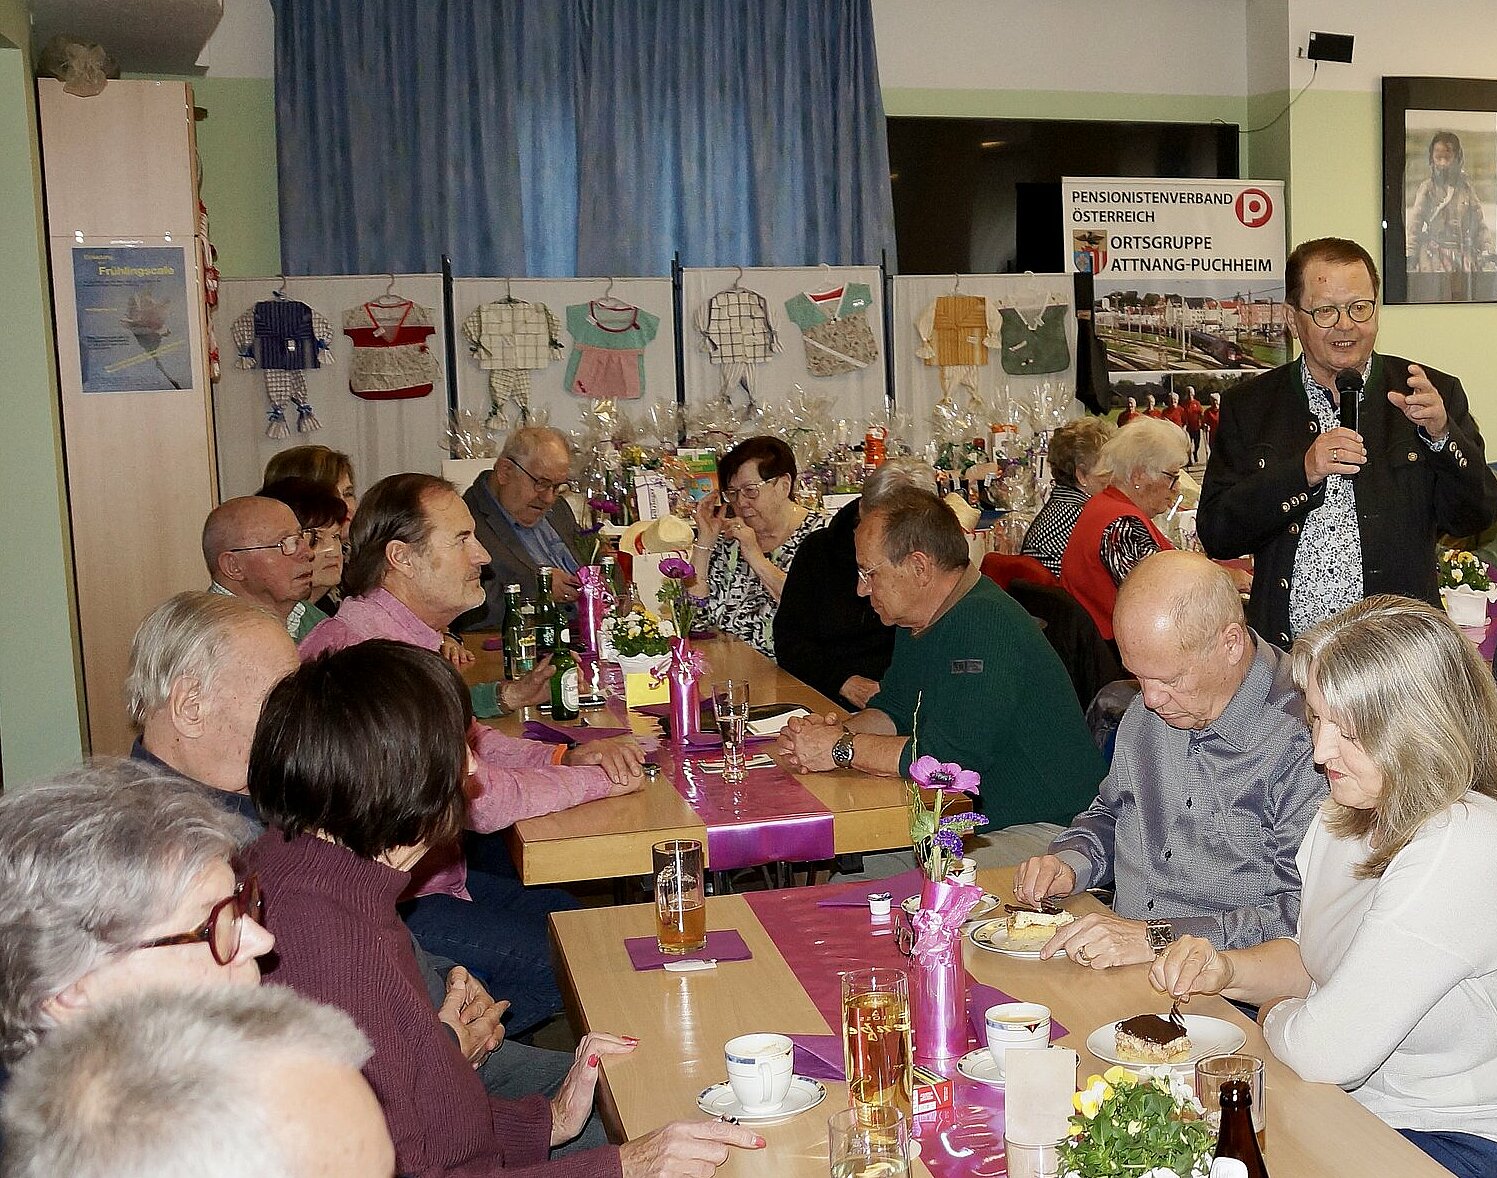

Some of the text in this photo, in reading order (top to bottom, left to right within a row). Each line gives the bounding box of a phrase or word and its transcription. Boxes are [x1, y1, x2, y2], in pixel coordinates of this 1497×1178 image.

[1072, 191, 1233, 205] PENSIONISTENVERBAND
[1072, 210, 1155, 223] ÖSTERREICH
[1110, 236, 1212, 250] ORTSGRUPPE
[1111, 258, 1272, 272] ATTNANG-PUCHHEIM
